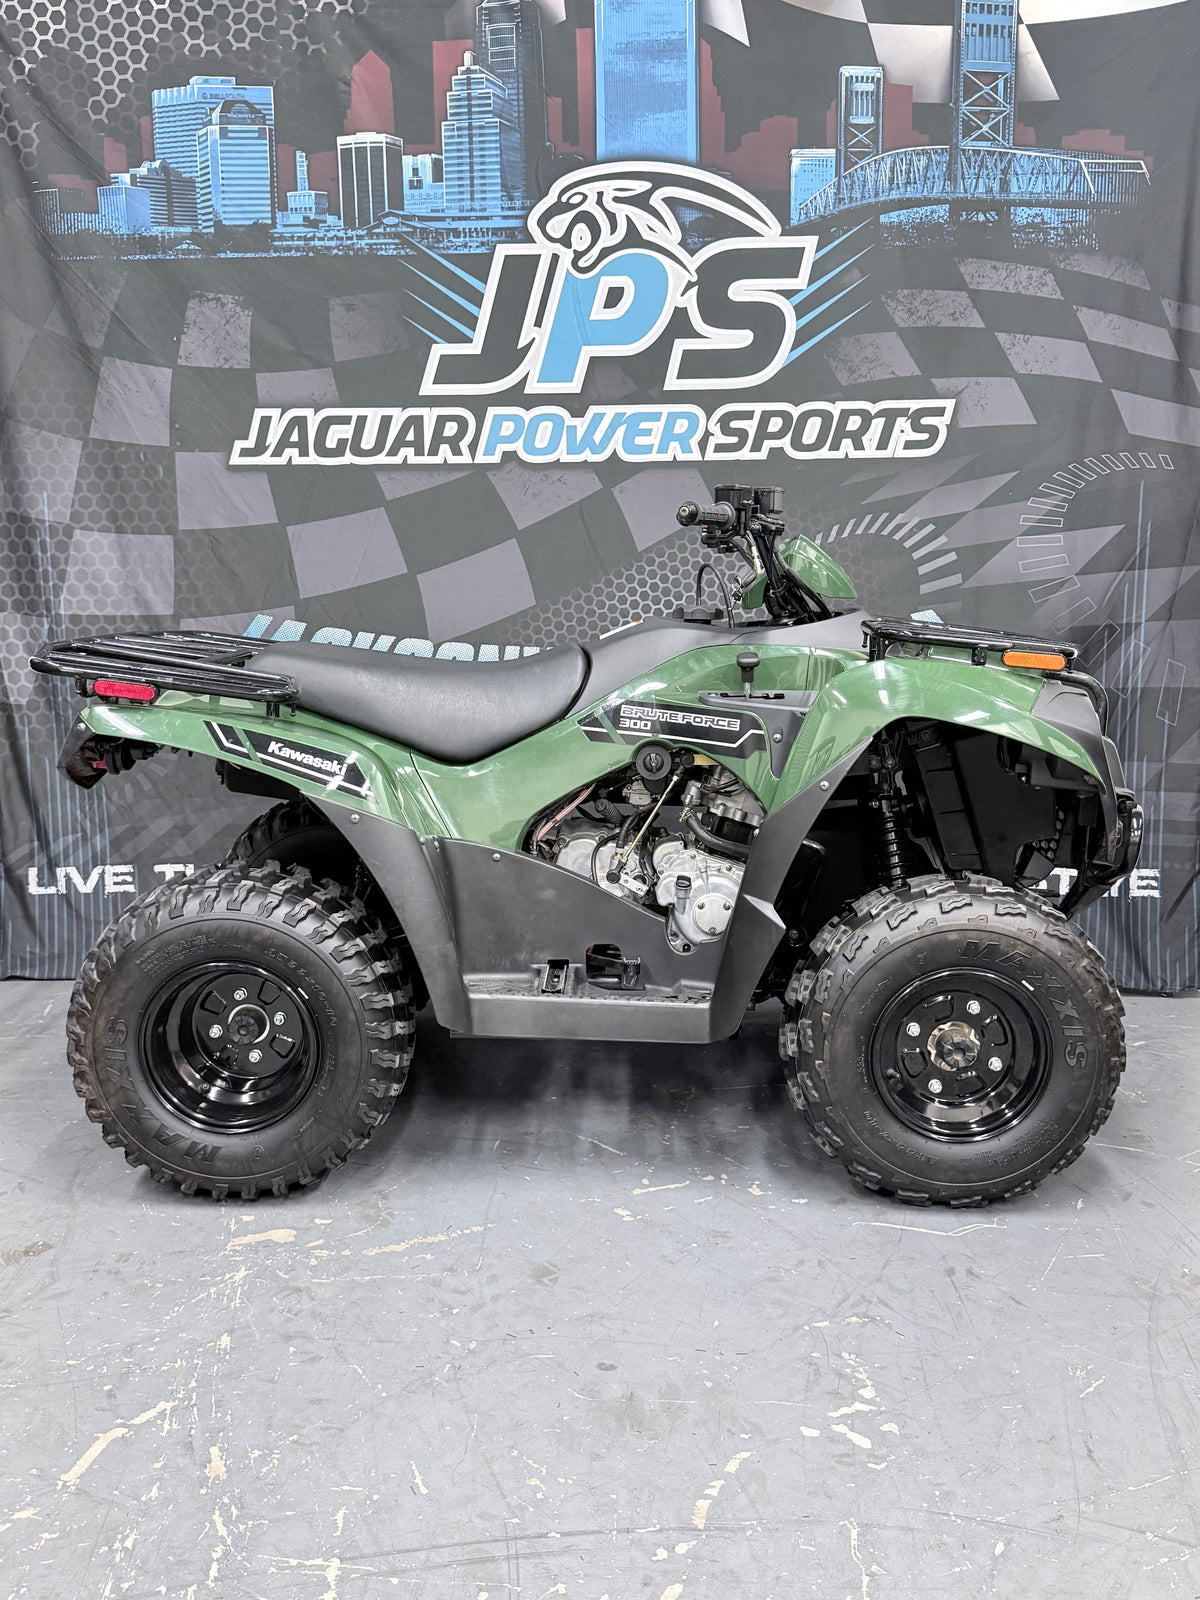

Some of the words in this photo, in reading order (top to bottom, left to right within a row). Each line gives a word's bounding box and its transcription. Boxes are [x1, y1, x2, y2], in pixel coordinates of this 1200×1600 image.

[419, 235, 819, 395] JPS
[229, 407, 474, 465] JAGUAR
[618, 717, 652, 731] 300
[267, 740, 348, 776] Kawasaki
[27, 864, 137, 898] LIVE
[956, 939, 1087, 1070] MAXXIS
[104, 1017, 224, 1164] MAXXIS
